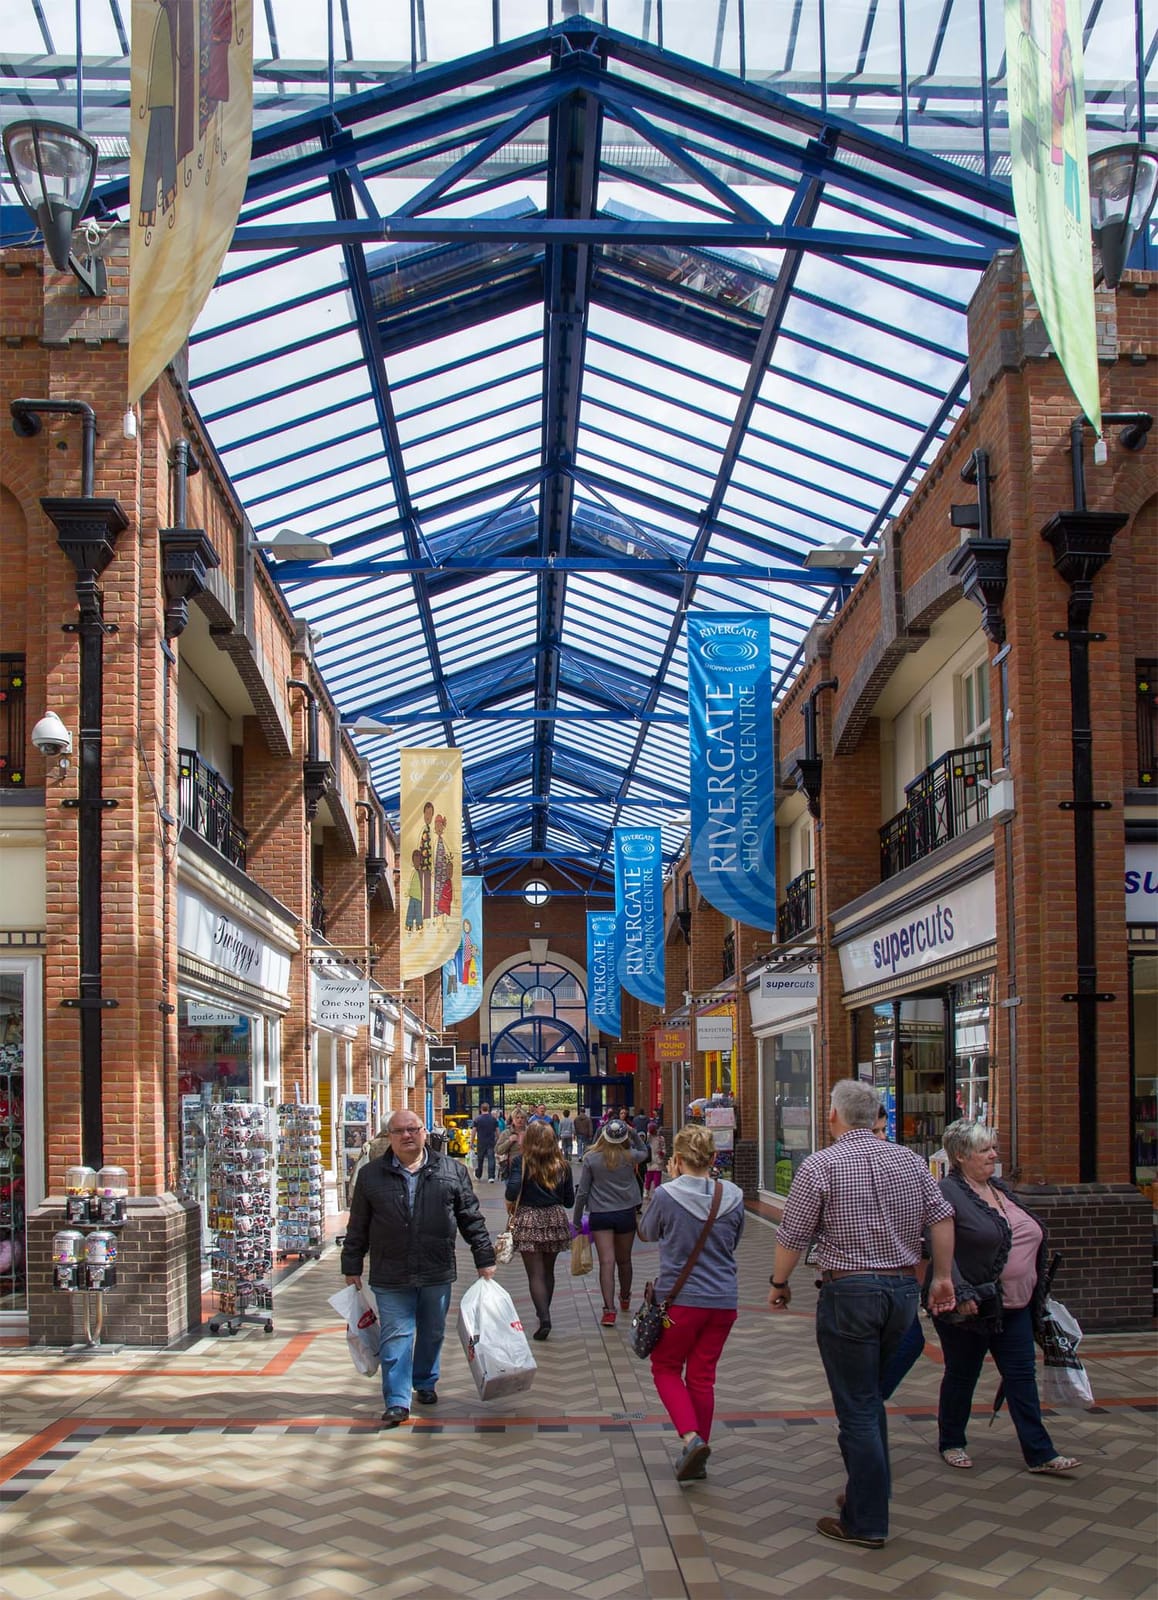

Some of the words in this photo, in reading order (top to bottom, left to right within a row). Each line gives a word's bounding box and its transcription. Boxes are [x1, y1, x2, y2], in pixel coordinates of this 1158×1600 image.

[699, 624, 759, 640] RIVERGATE
[704, 662, 734, 673] SHOPPING
[735, 663, 756, 673] CENTRE
[738, 684, 758, 762] CENTRE
[705, 682, 738, 873] RIVERGATE
[740, 768, 760, 873] SHOPPING
[643, 867, 654, 912] CENTRE
[624, 866, 644, 976] RIVERGATE
[873, 903, 954, 973] supercuts
[213, 915, 260, 974] Twiggy's
[644, 913, 656, 975] SHOPPING
[320, 983, 364, 994] Twiggy's
[593, 939, 607, 1016] RIVERGATE
[766, 980, 815, 990] supercuts
[320, 1012, 340, 1020] Gift
[342, 1012, 366, 1021] Shop
[321, 999, 341, 1007] One
[344, 999, 366, 1009] Stop
[658, 1042, 686, 1050] POUND
[661, 1050, 682, 1058] SHOP
